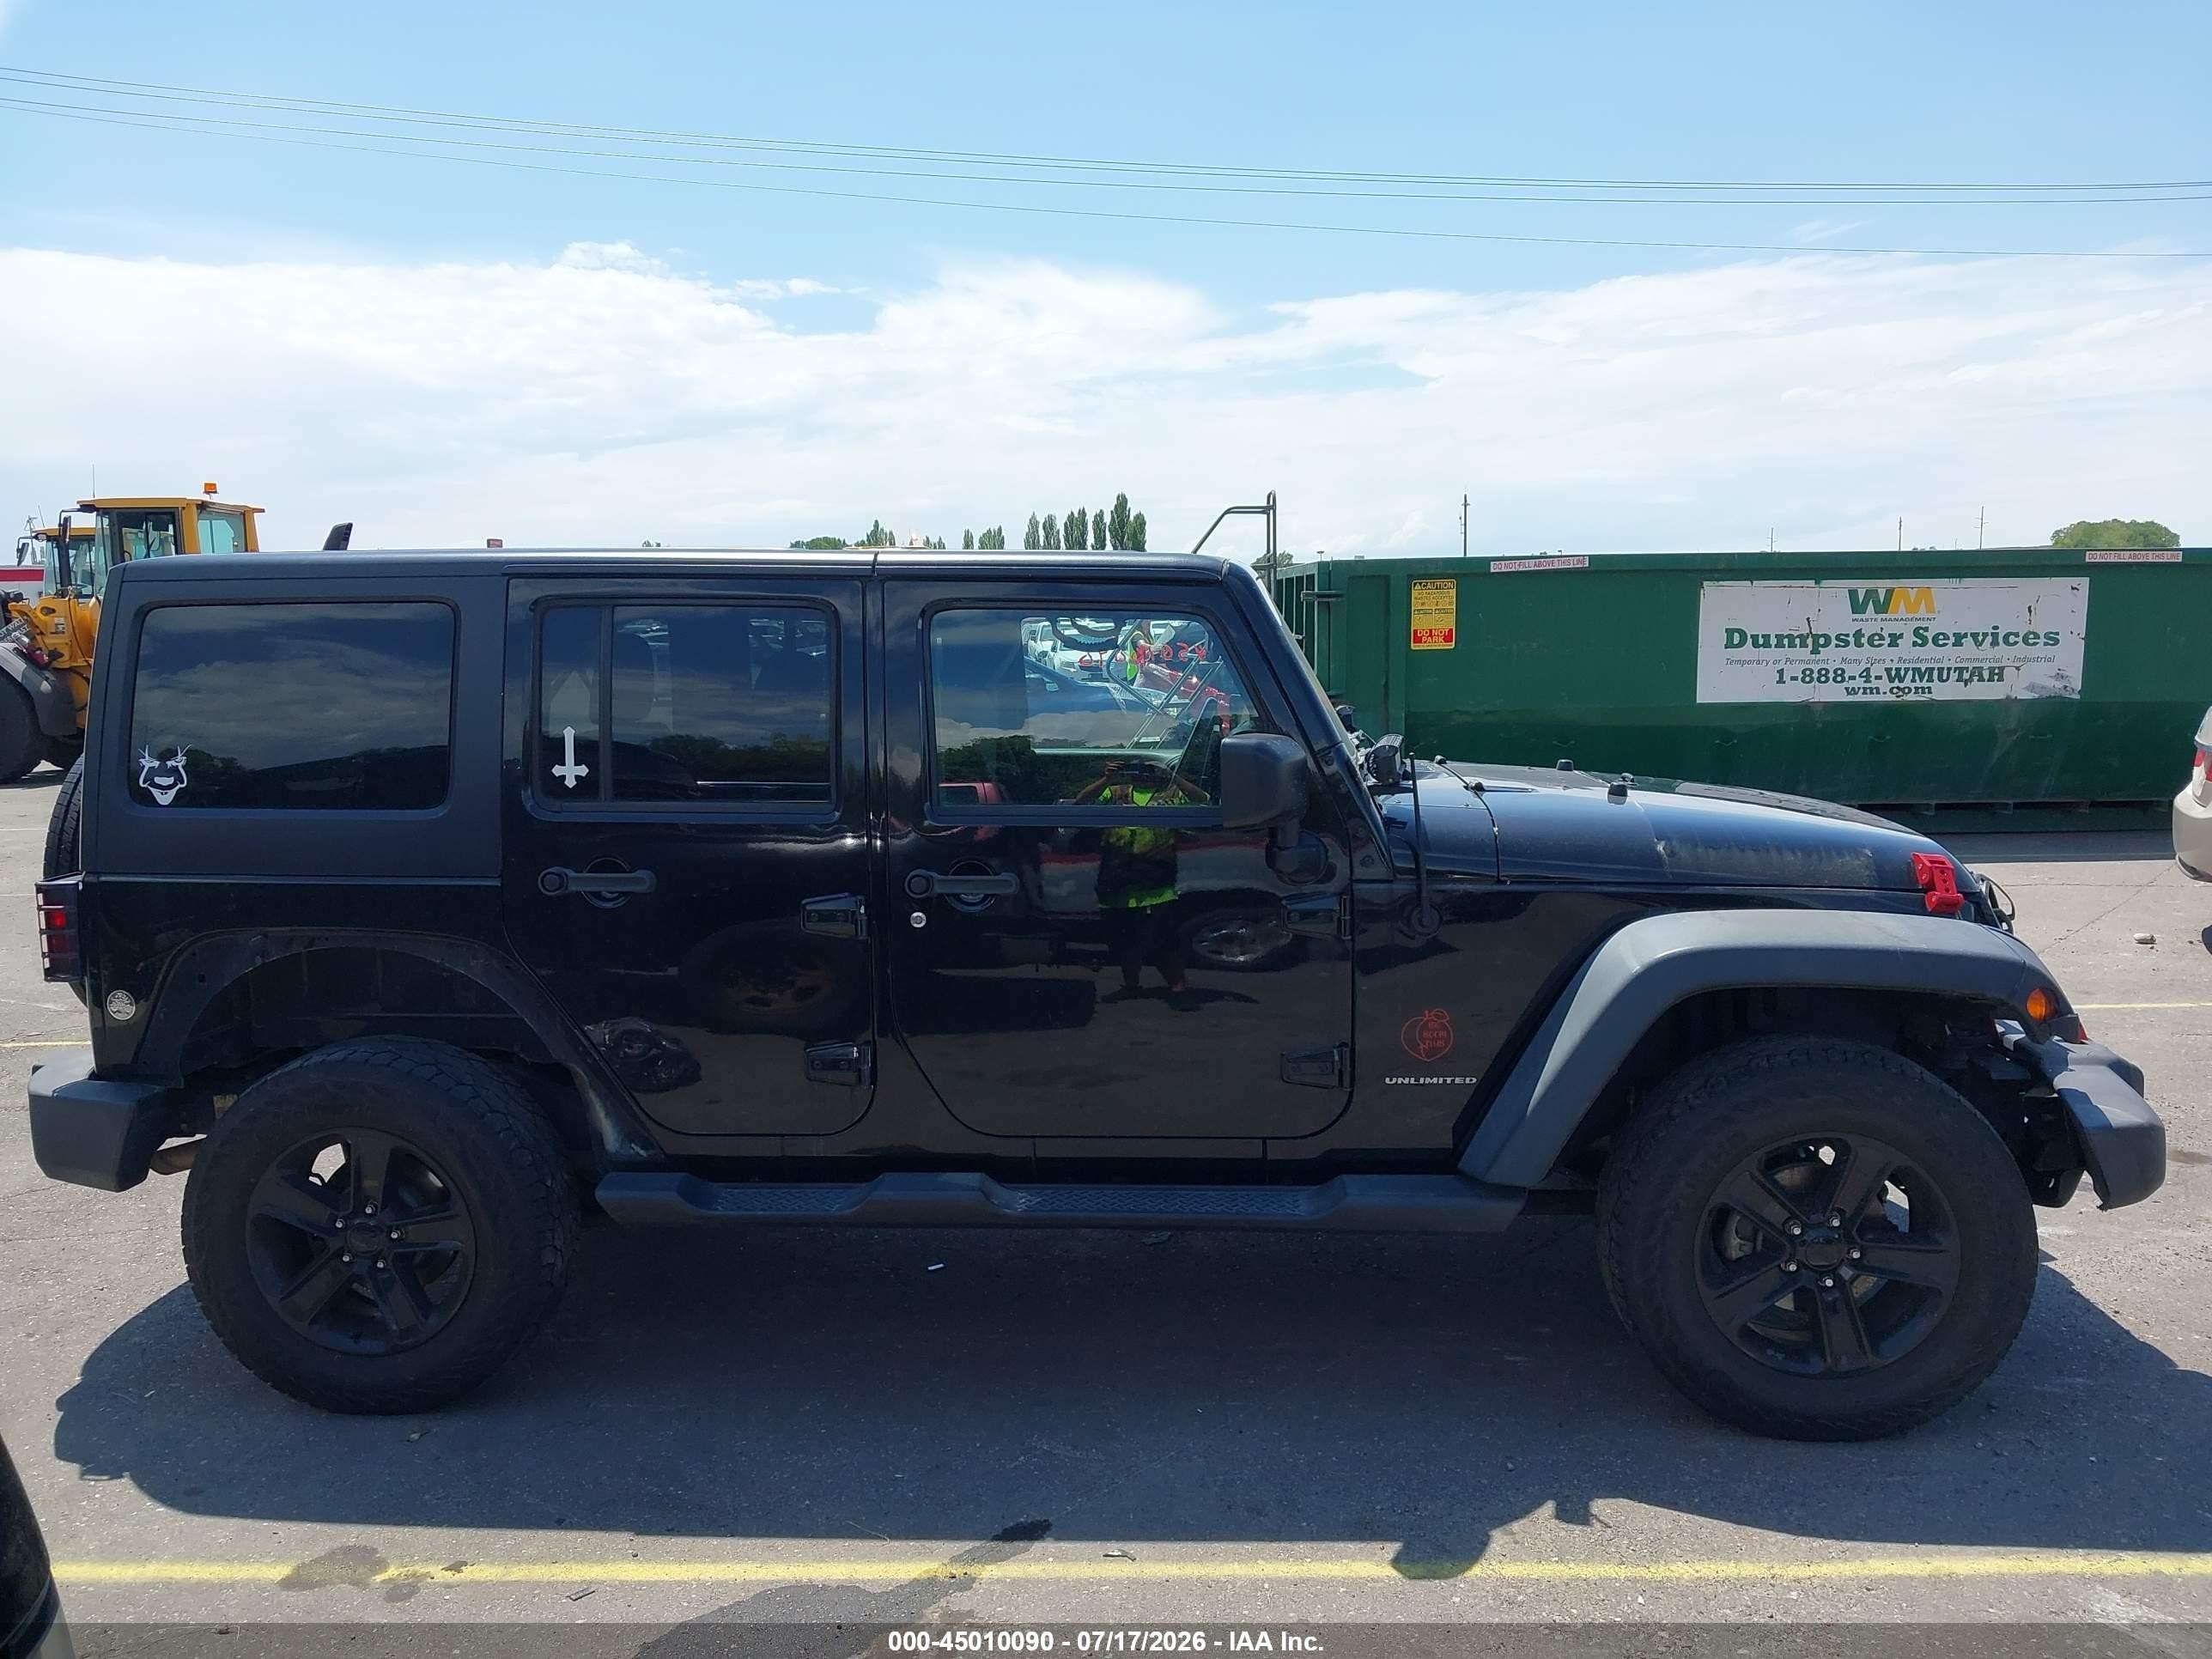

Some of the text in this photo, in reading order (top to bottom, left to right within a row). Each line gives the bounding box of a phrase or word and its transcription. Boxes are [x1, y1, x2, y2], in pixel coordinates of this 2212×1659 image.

[1573, 557, 1587, 566] LINE
[1848, 586, 1936, 614] WM
[1724, 625, 2060, 655] Dumpster Services
[1725, 658, 1770, 666] Temporary
[1784, 657, 1830, 665] Permanent
[1840, 657, 1863, 666] Many
[1865, 657, 1887, 665] Sizes
[1897, 656, 1944, 665] Residential
[1954, 655, 2003, 664] Commercial
[2013, 654, 2055, 663] Industrial
[1776, 666, 2005, 684] 1-888-4-WMUTAH
[1844, 685, 1933, 696] wm.com
